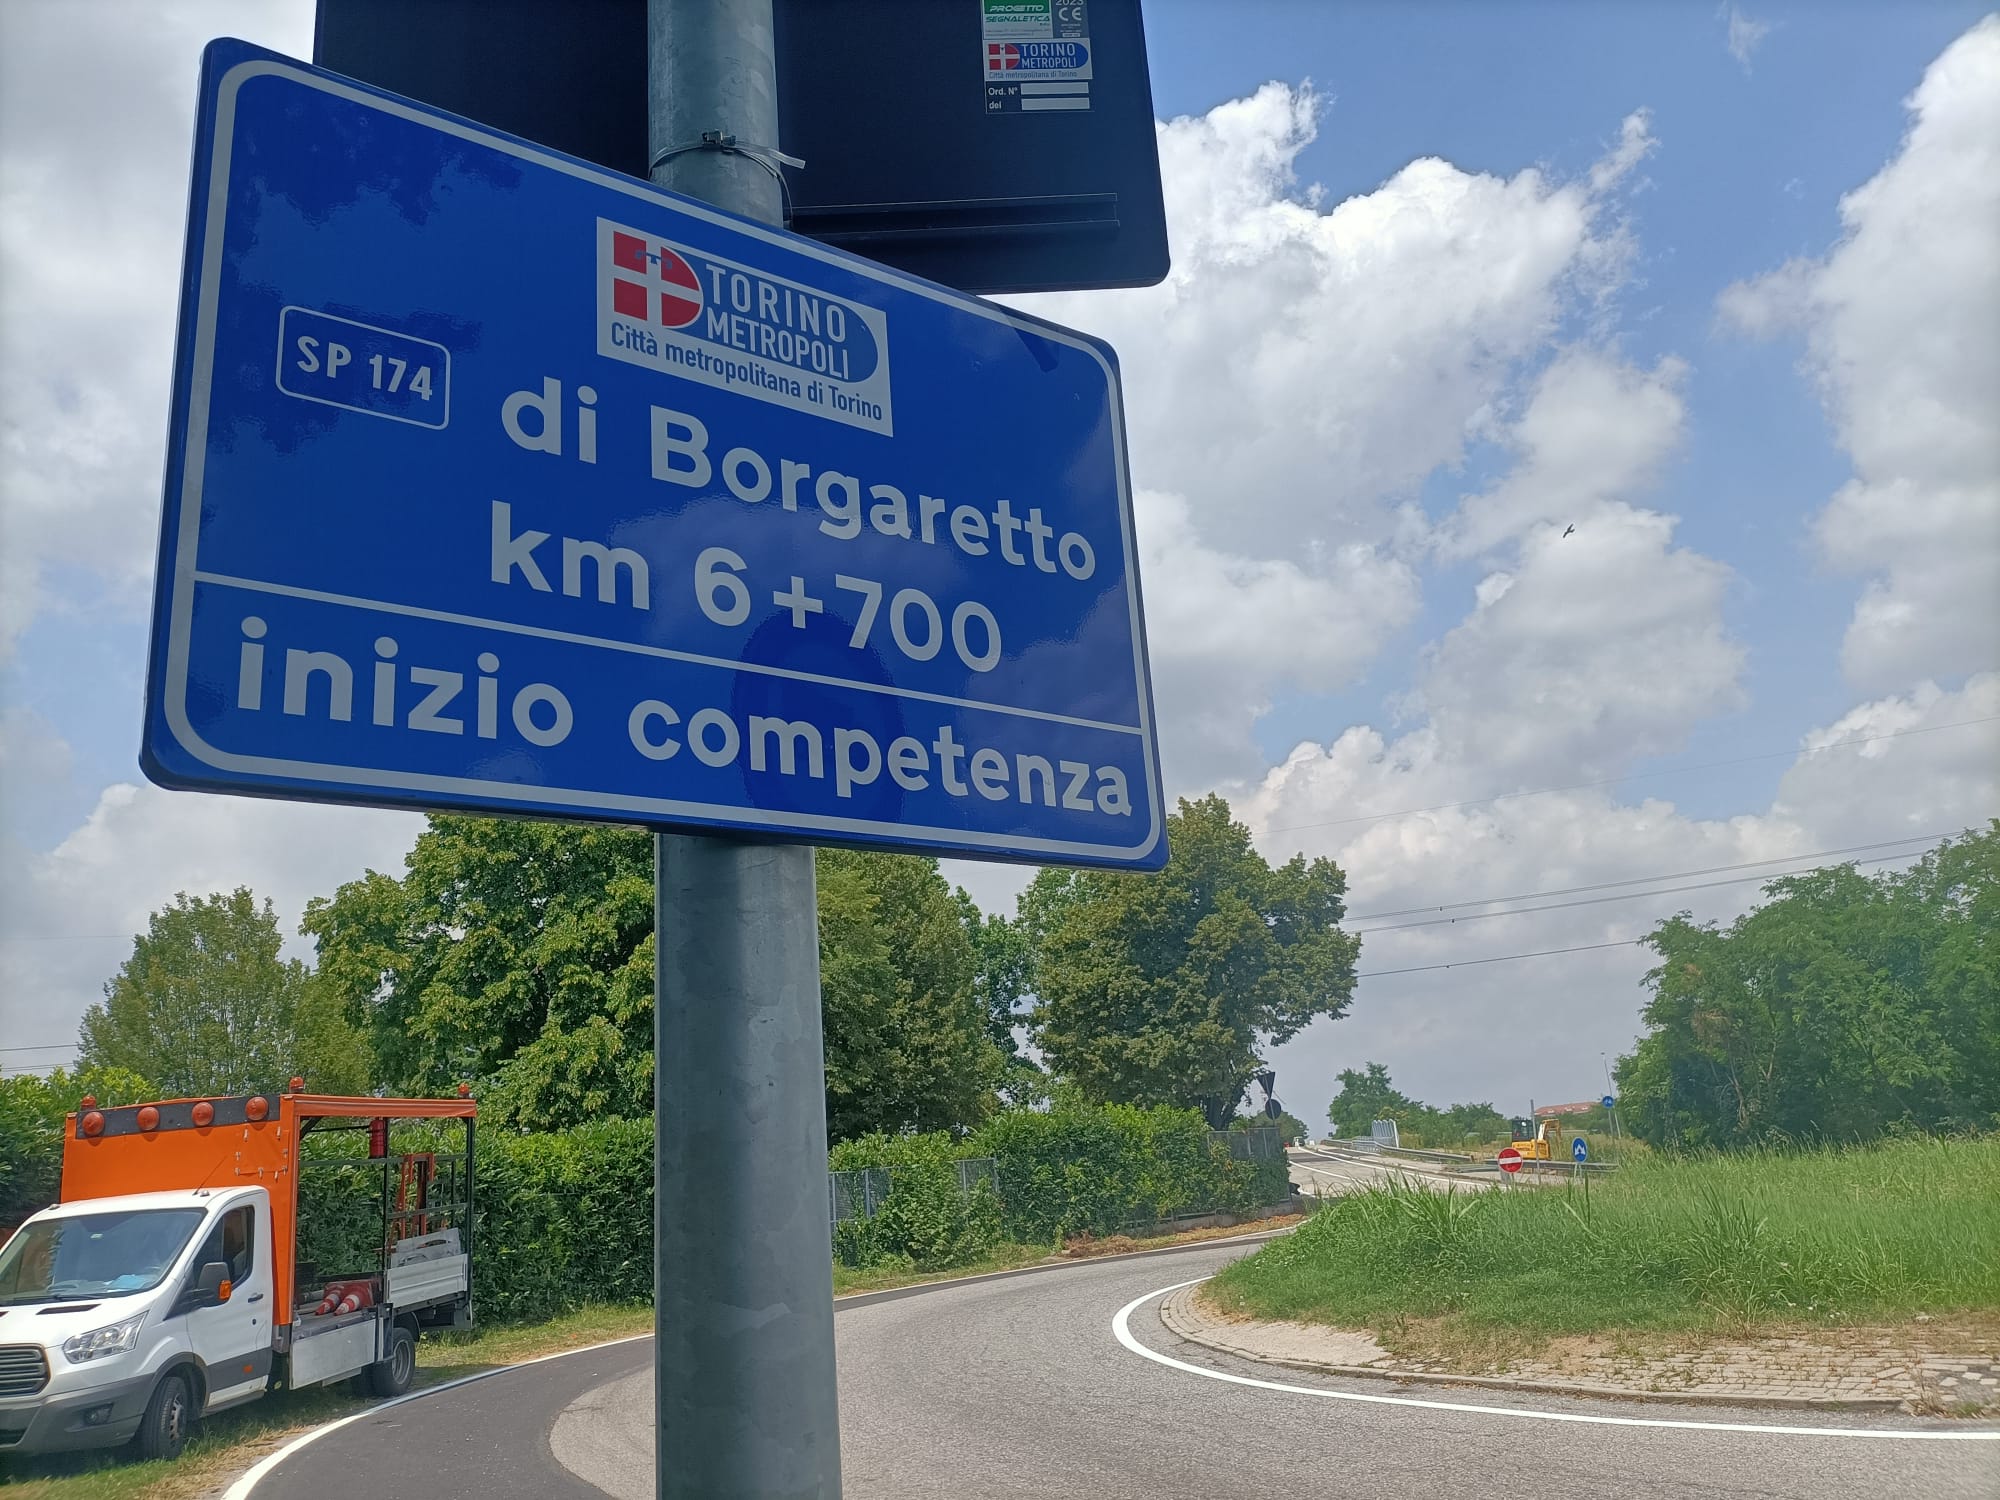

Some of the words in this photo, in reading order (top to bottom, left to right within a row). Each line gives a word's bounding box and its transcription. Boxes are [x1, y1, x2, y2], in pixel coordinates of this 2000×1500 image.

[985, 15, 1050, 23] SEGNALETICA
[1021, 43, 1076, 56] TORINO
[988, 71, 1004, 79] Città
[1005, 70, 1049, 79] metropolitana
[1050, 70, 1057, 78] di
[1058, 70, 1078, 78] Torino
[988, 87, 1007, 96] Ord.
[1022, 57, 1077, 69] METROPOLI
[988, 100, 1002, 109] del
[705, 263, 847, 343] TORINO
[297, 335, 352, 378] SP
[369, 354, 433, 400] 174
[611, 321, 658, 357] Città
[665, 343, 801, 399] metropolitana
[807, 379, 824, 405] di
[828, 385, 882, 421] Torino
[706, 306, 850, 380] METROPOLI
[501, 376, 598, 464] di
[650, 405, 1096, 581] Borgaretto
[491, 500, 650, 611] km
[238, 616, 574, 747] inizio
[628, 699, 1133, 816] competenza
